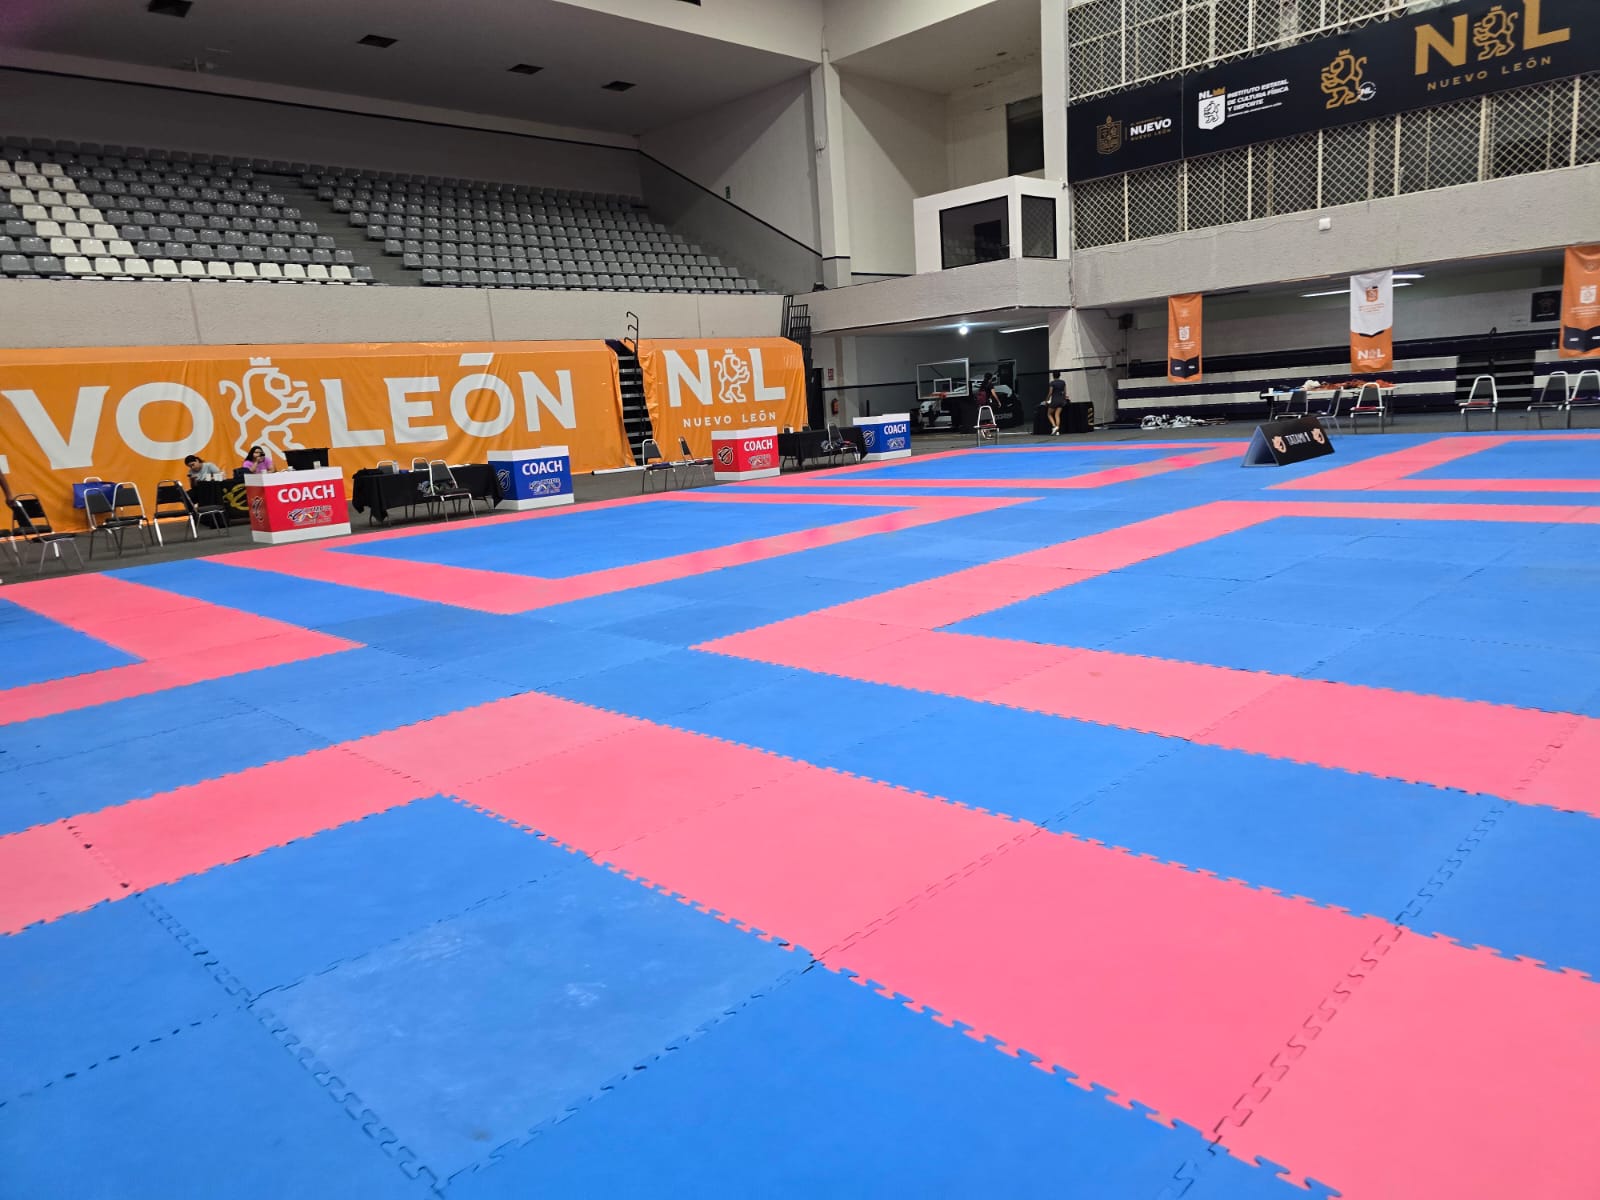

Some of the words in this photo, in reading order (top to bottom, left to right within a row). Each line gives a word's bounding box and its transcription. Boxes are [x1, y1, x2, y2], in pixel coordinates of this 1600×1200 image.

[1427, 70, 1488, 92] NUEVO
[1501, 55, 1552, 76] LEÓN
[1227, 86, 1260, 98] INSTITUTO
[1262, 79, 1289, 90] ESTATAL
[1227, 98, 1236, 106] DE
[1237, 91, 1266, 103] CULTURA
[1233, 99, 1264, 110] DEPORTE
[1130, 118, 1172, 136] NUEVO
[0, 381, 214, 474] VO
[319, 352, 577, 449] LEÓN
[683, 415, 732, 428] NUEVO
[742, 410, 777, 423] LEÓN
[883, 423, 907, 435] COACH
[743, 439, 773, 452] COACH
[522, 460, 563, 476] COACH
[277, 484, 335, 503] COACH
